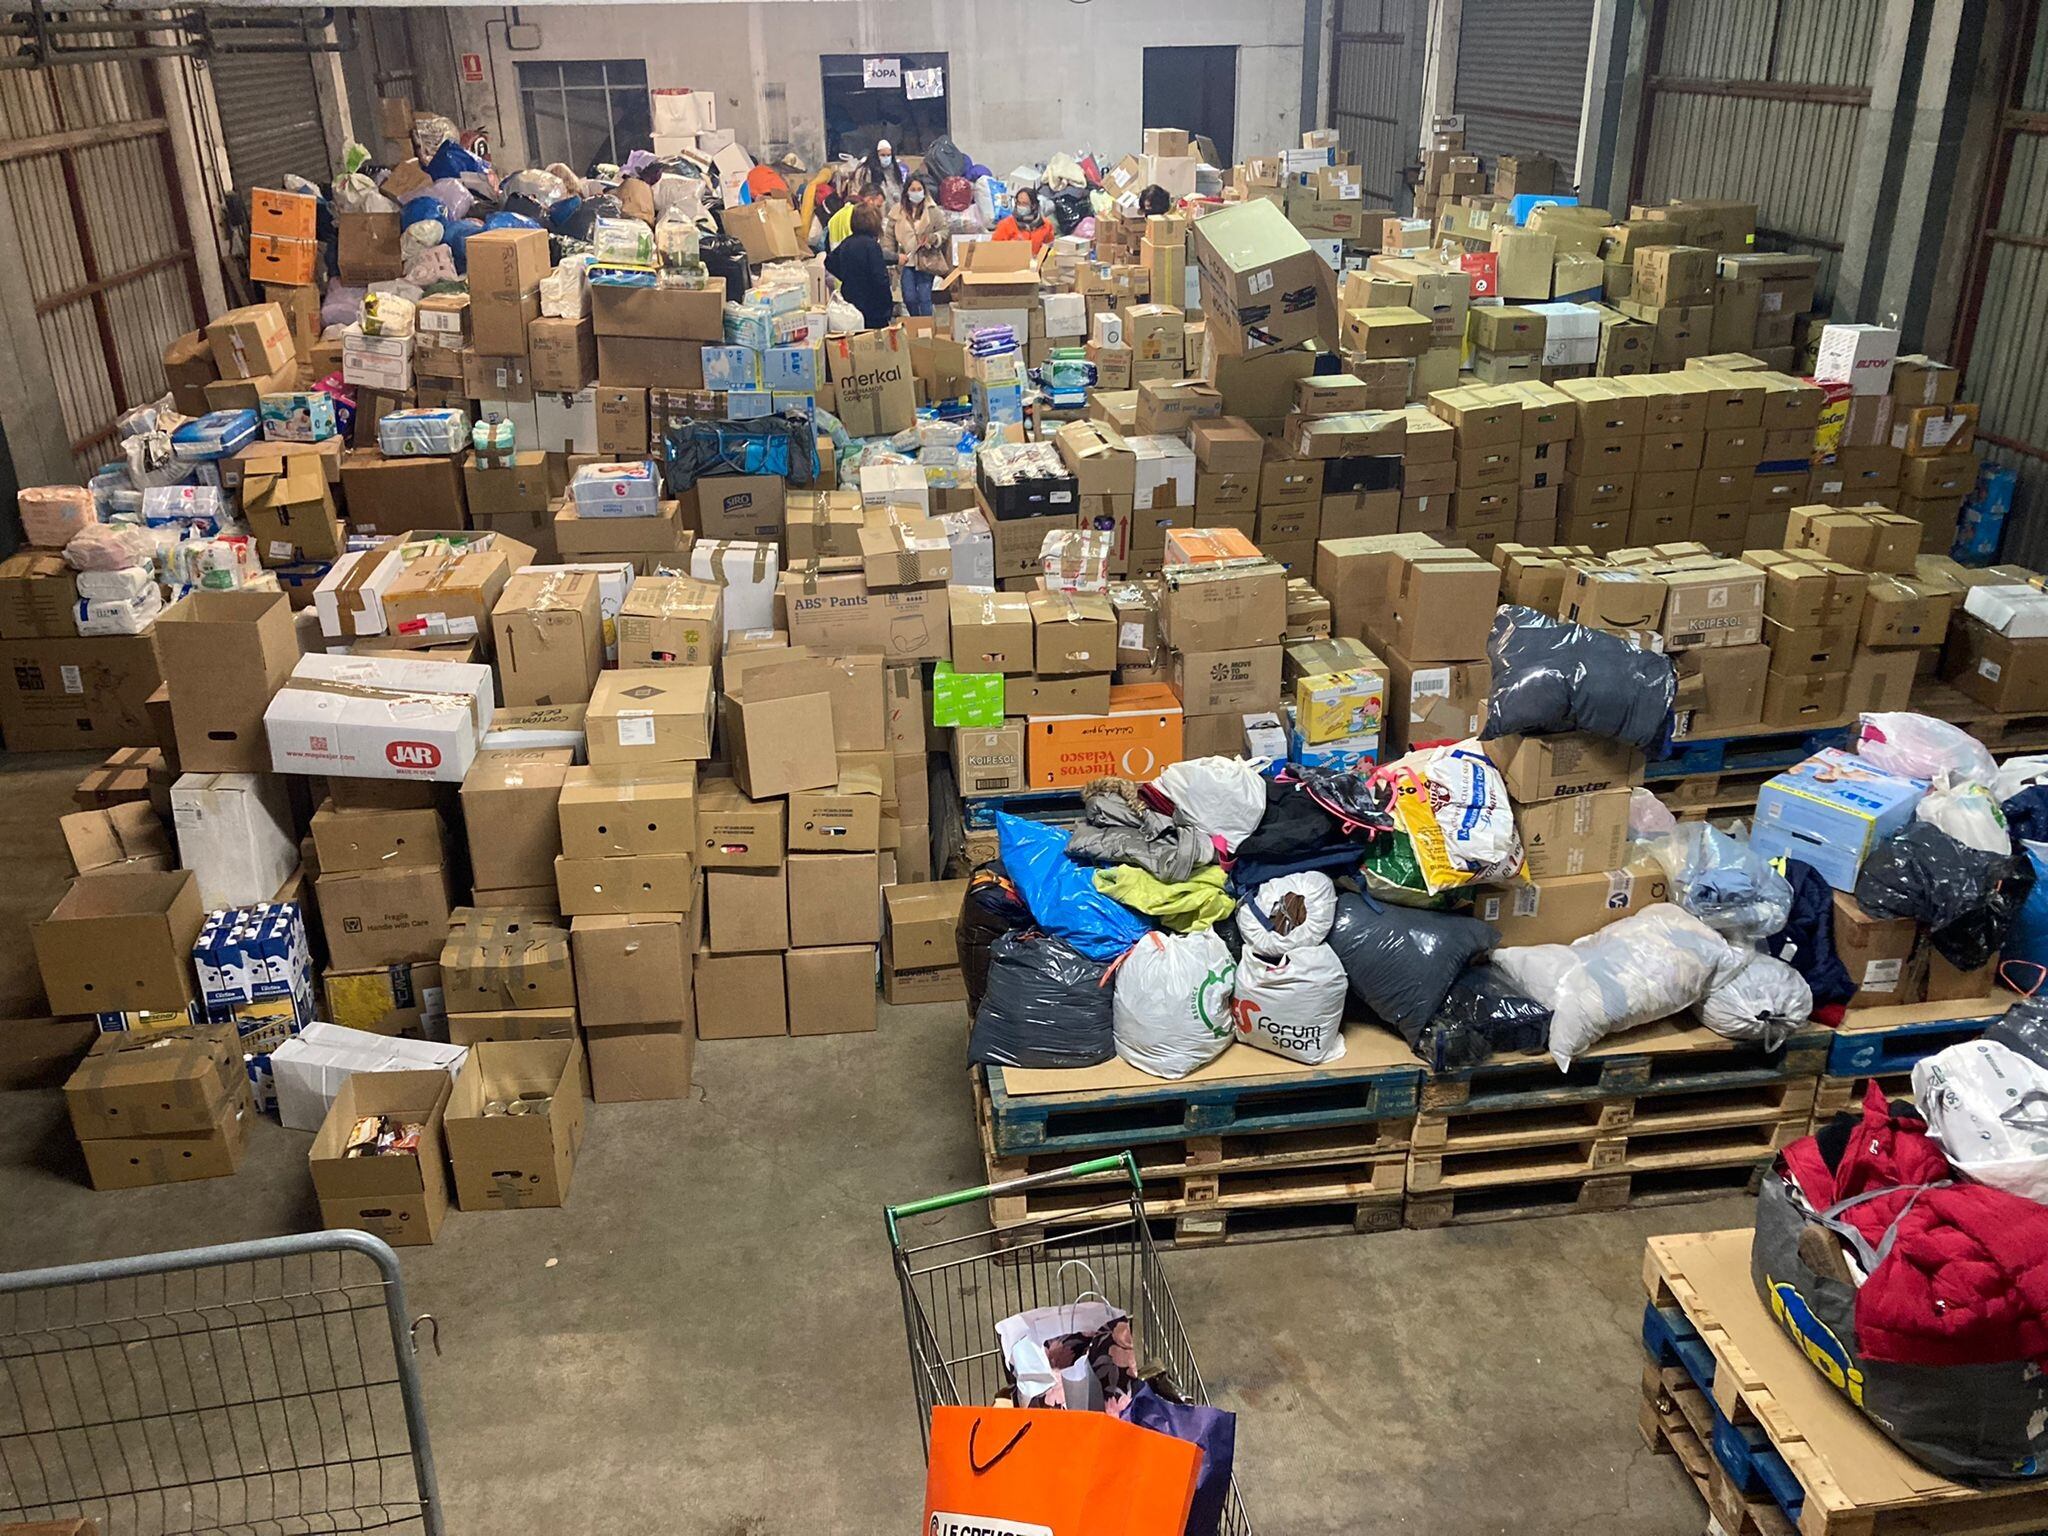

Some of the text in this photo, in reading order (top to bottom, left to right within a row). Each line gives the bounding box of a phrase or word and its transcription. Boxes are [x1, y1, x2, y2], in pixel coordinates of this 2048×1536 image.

[841, 365, 902, 389] merkal
[404, 441, 414, 453] 4
[726, 495, 750, 507] SIRO
[830, 594, 868, 607] Pants
[1689, 616, 1743, 632] KOIPESOL
[520, 715, 569, 726] COMIDA
[393, 746, 434, 765] JAR
[968, 755, 1015, 766] KOIPESOL
[1059, 750, 1116, 766] Velasco
[1060, 764, 1117, 778] Huevos
[1553, 781, 1611, 796] Baxter
[1832, 790, 1883, 810] BABY
[1510, 855, 1518, 867] 1
[384, 912, 408, 921] Fragile
[367, 919, 429, 932] Handle with Care
[1190, 986, 1199, 1020] REDUCE
[1272, 1035, 1321, 1051] sport
